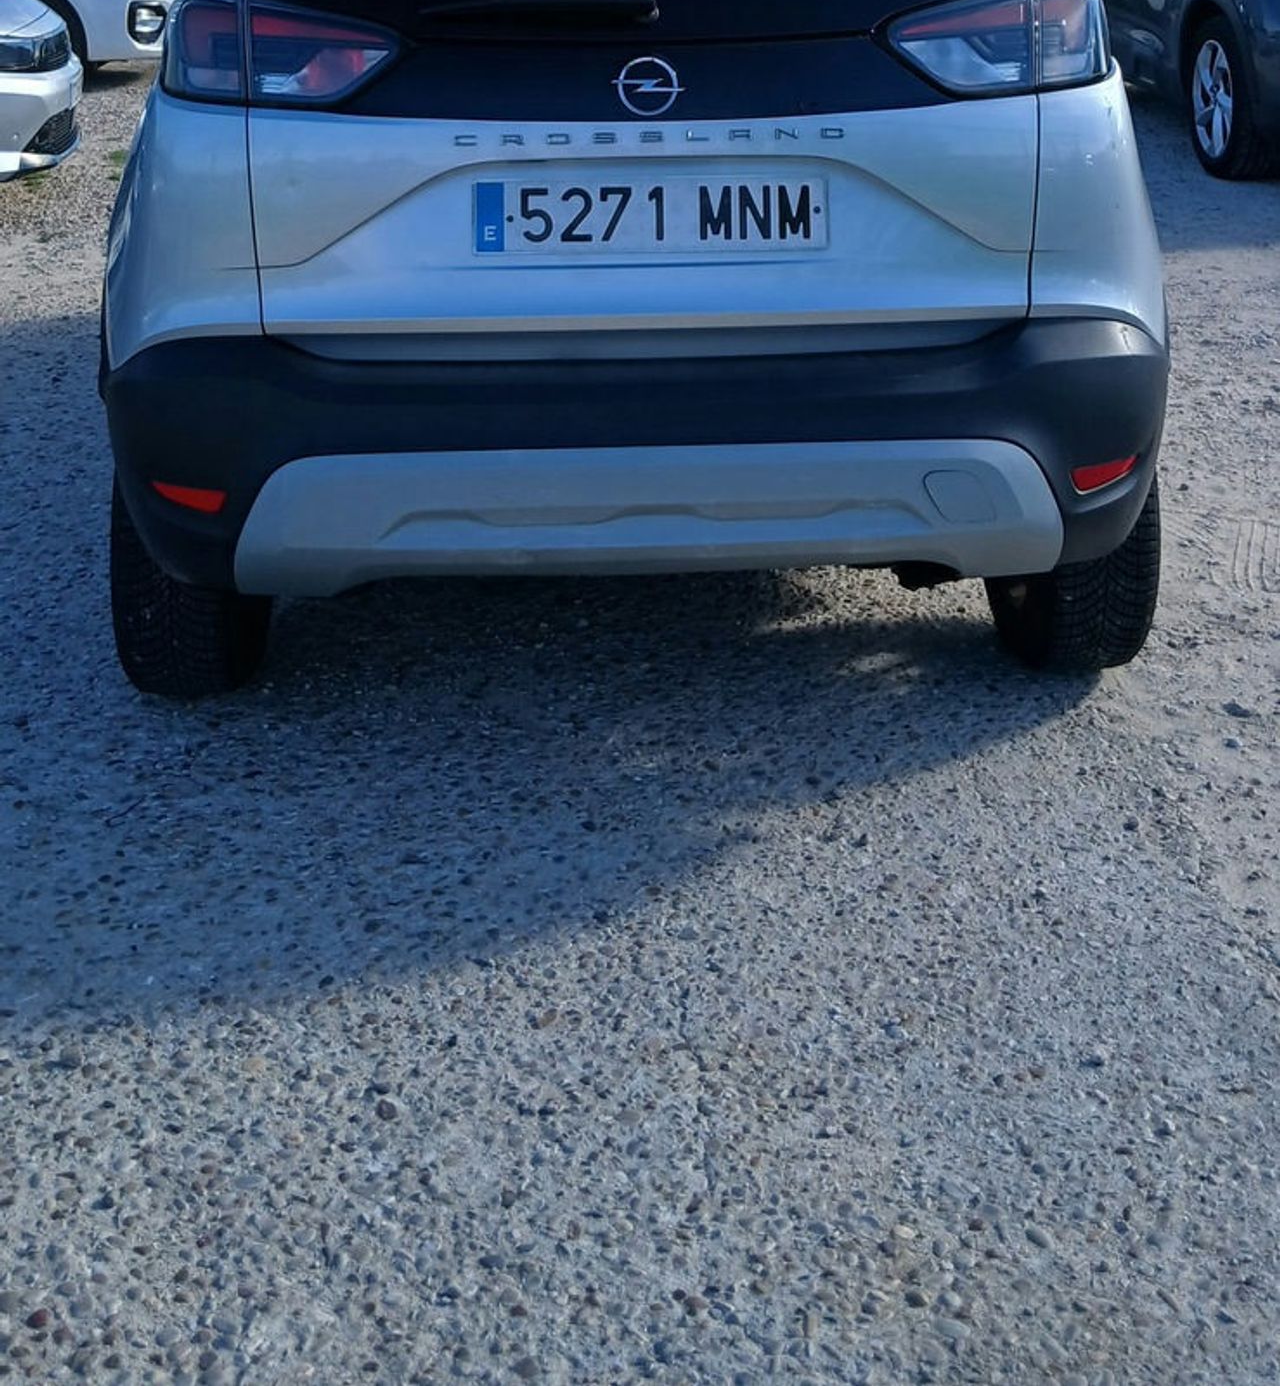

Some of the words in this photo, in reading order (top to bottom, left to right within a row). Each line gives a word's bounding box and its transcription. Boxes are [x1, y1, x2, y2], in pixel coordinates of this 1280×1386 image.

[453, 126, 845, 147] CROSSLAND
[519, 186, 665, 242] 5271
[699, 185, 811, 241] MNM
[484, 226, 497, 241] E
